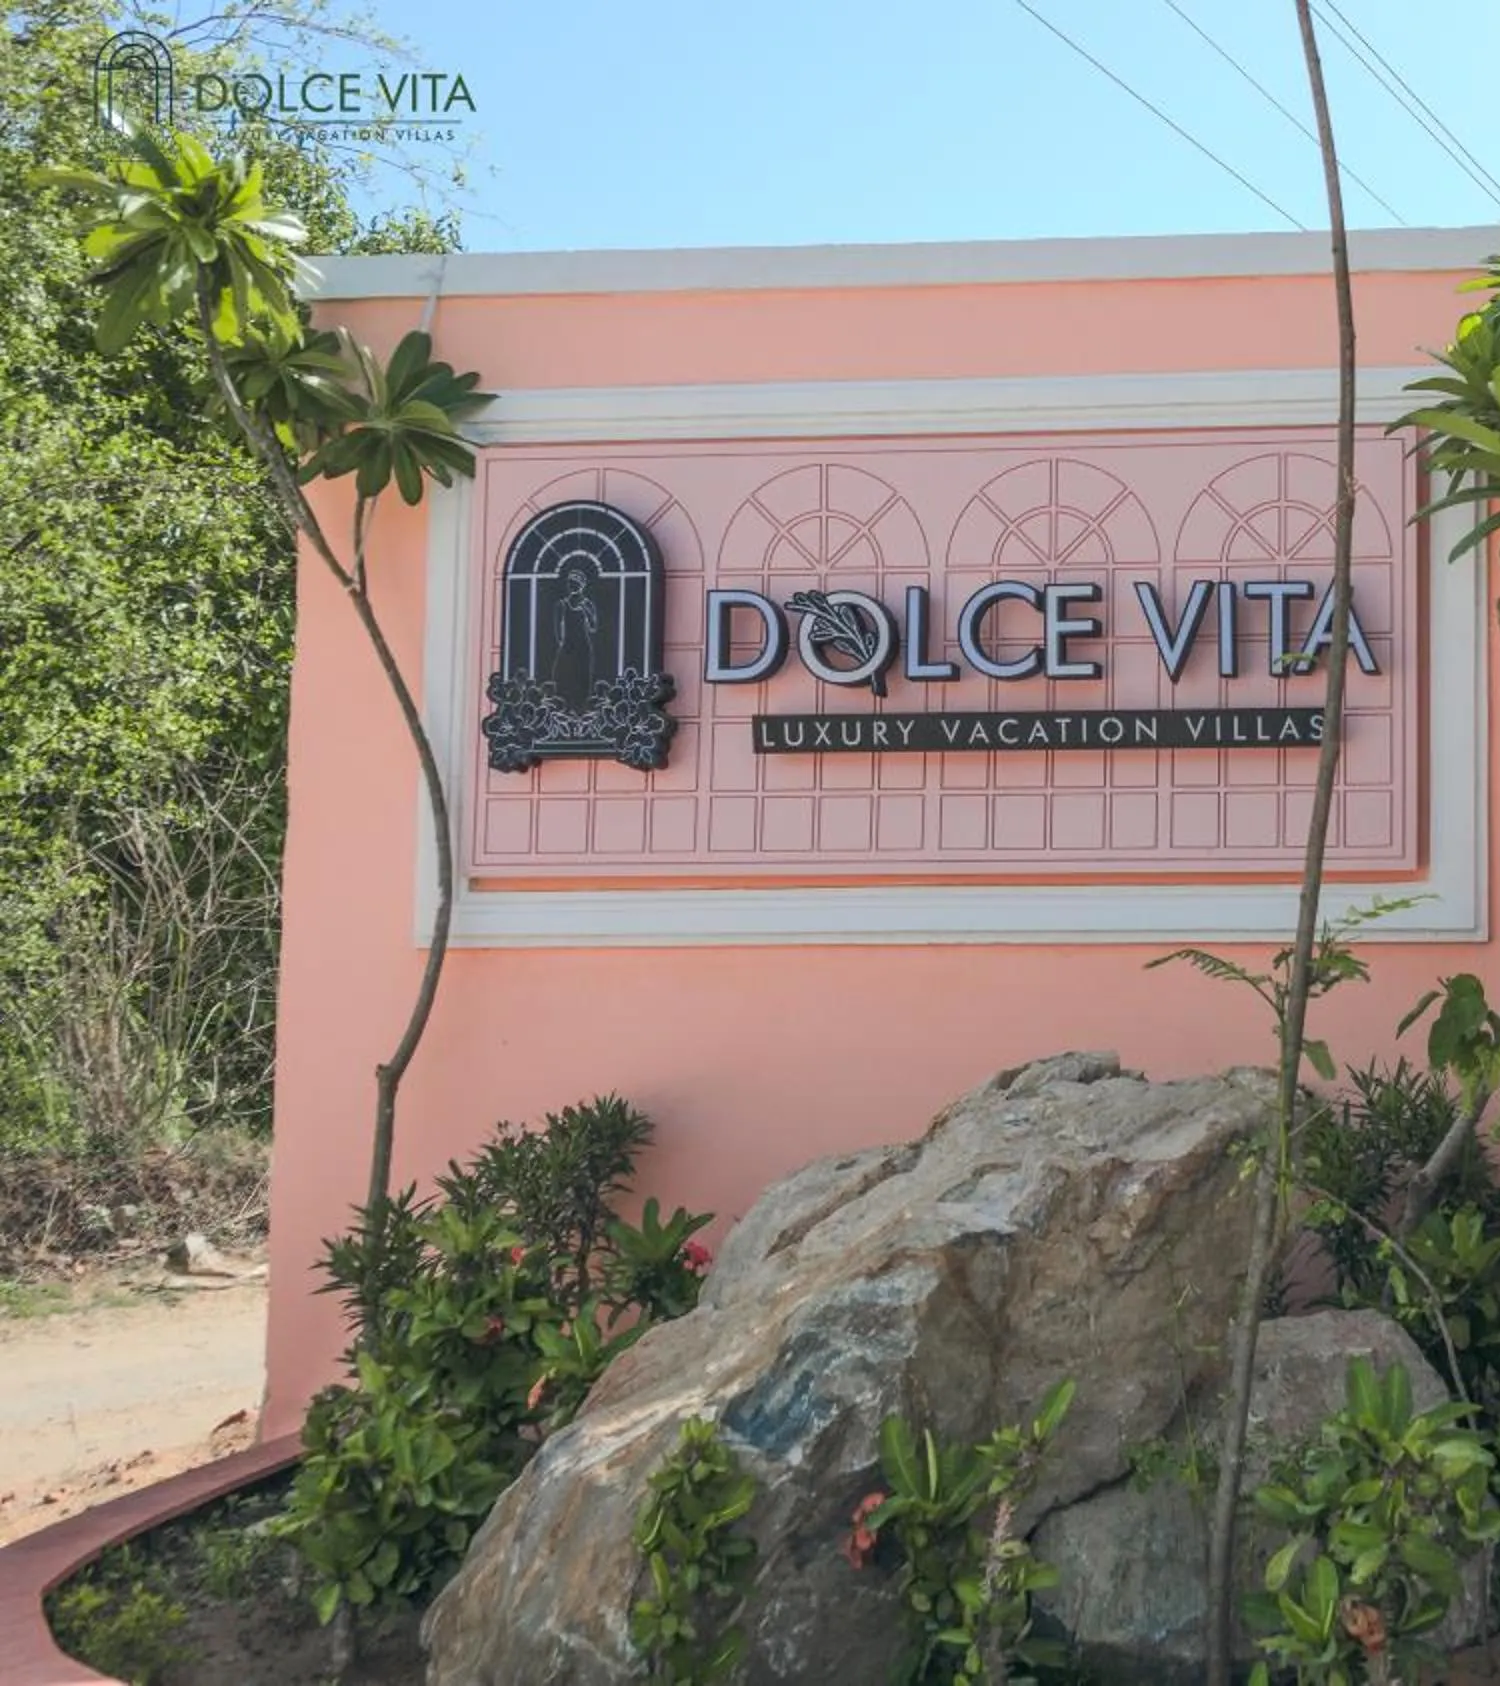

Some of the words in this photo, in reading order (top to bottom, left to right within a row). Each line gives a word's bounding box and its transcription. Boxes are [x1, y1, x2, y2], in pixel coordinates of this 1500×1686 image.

[704, 579, 1103, 698] DOLCE
[1134, 579, 1381, 684] VITA
[761, 719, 915, 748] LUXURY
[941, 715, 1158, 745] VACATION
[1185, 714, 1325, 741] VILLAS
